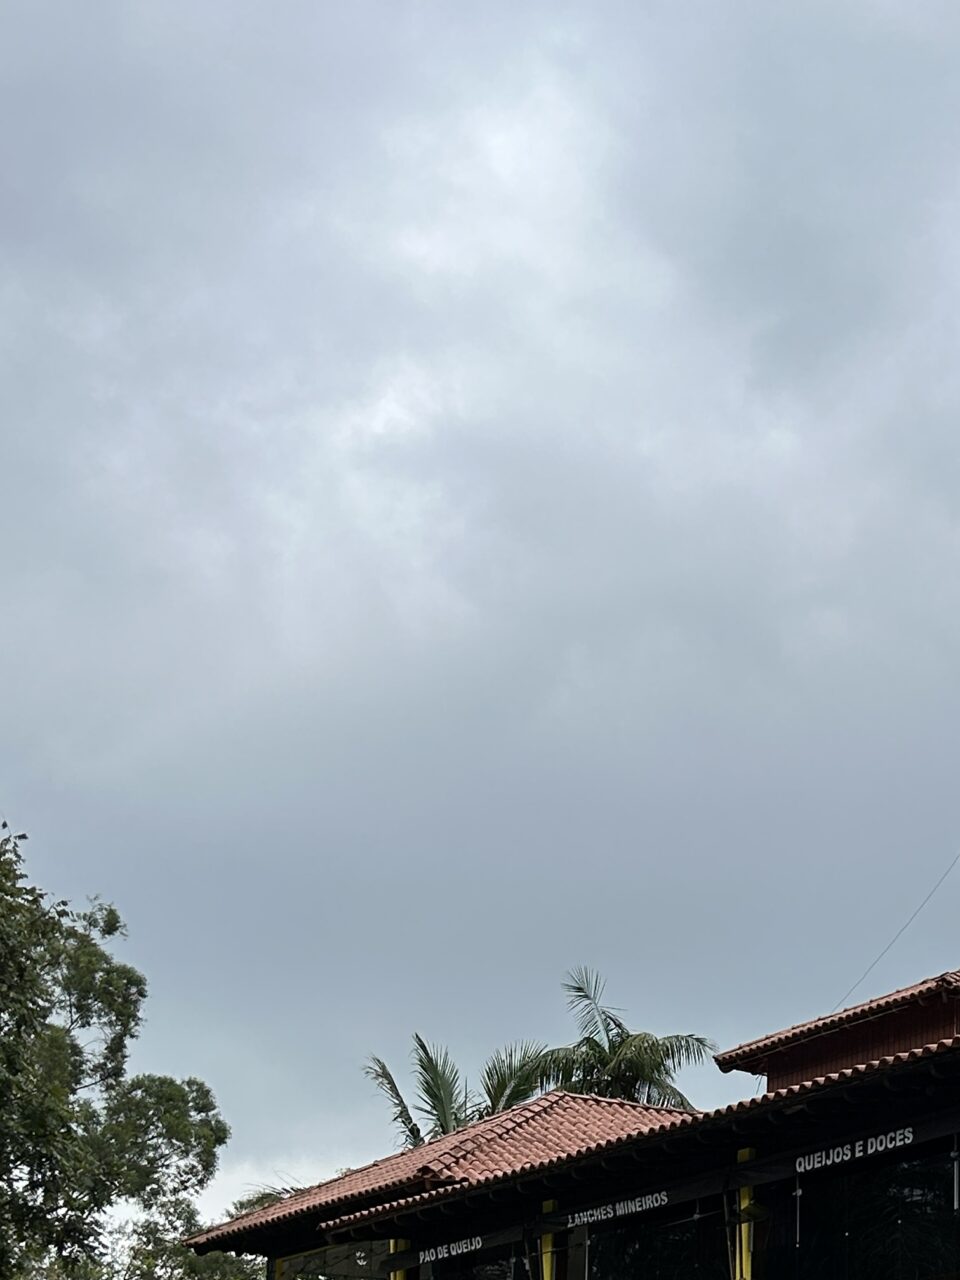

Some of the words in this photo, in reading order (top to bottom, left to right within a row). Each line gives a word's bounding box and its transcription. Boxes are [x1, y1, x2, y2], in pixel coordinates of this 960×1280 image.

[796, 1144, 852, 1173] QUEIJOS
[855, 1141, 864, 1158] E
[867, 1127, 913, 1154] DOCES
[567, 1203, 614, 1228] LANCHES
[615, 1191, 668, 1216] MINEIROS
[437, 1244, 449, 1259] DE
[450, 1236, 482, 1256] QUEIJO
